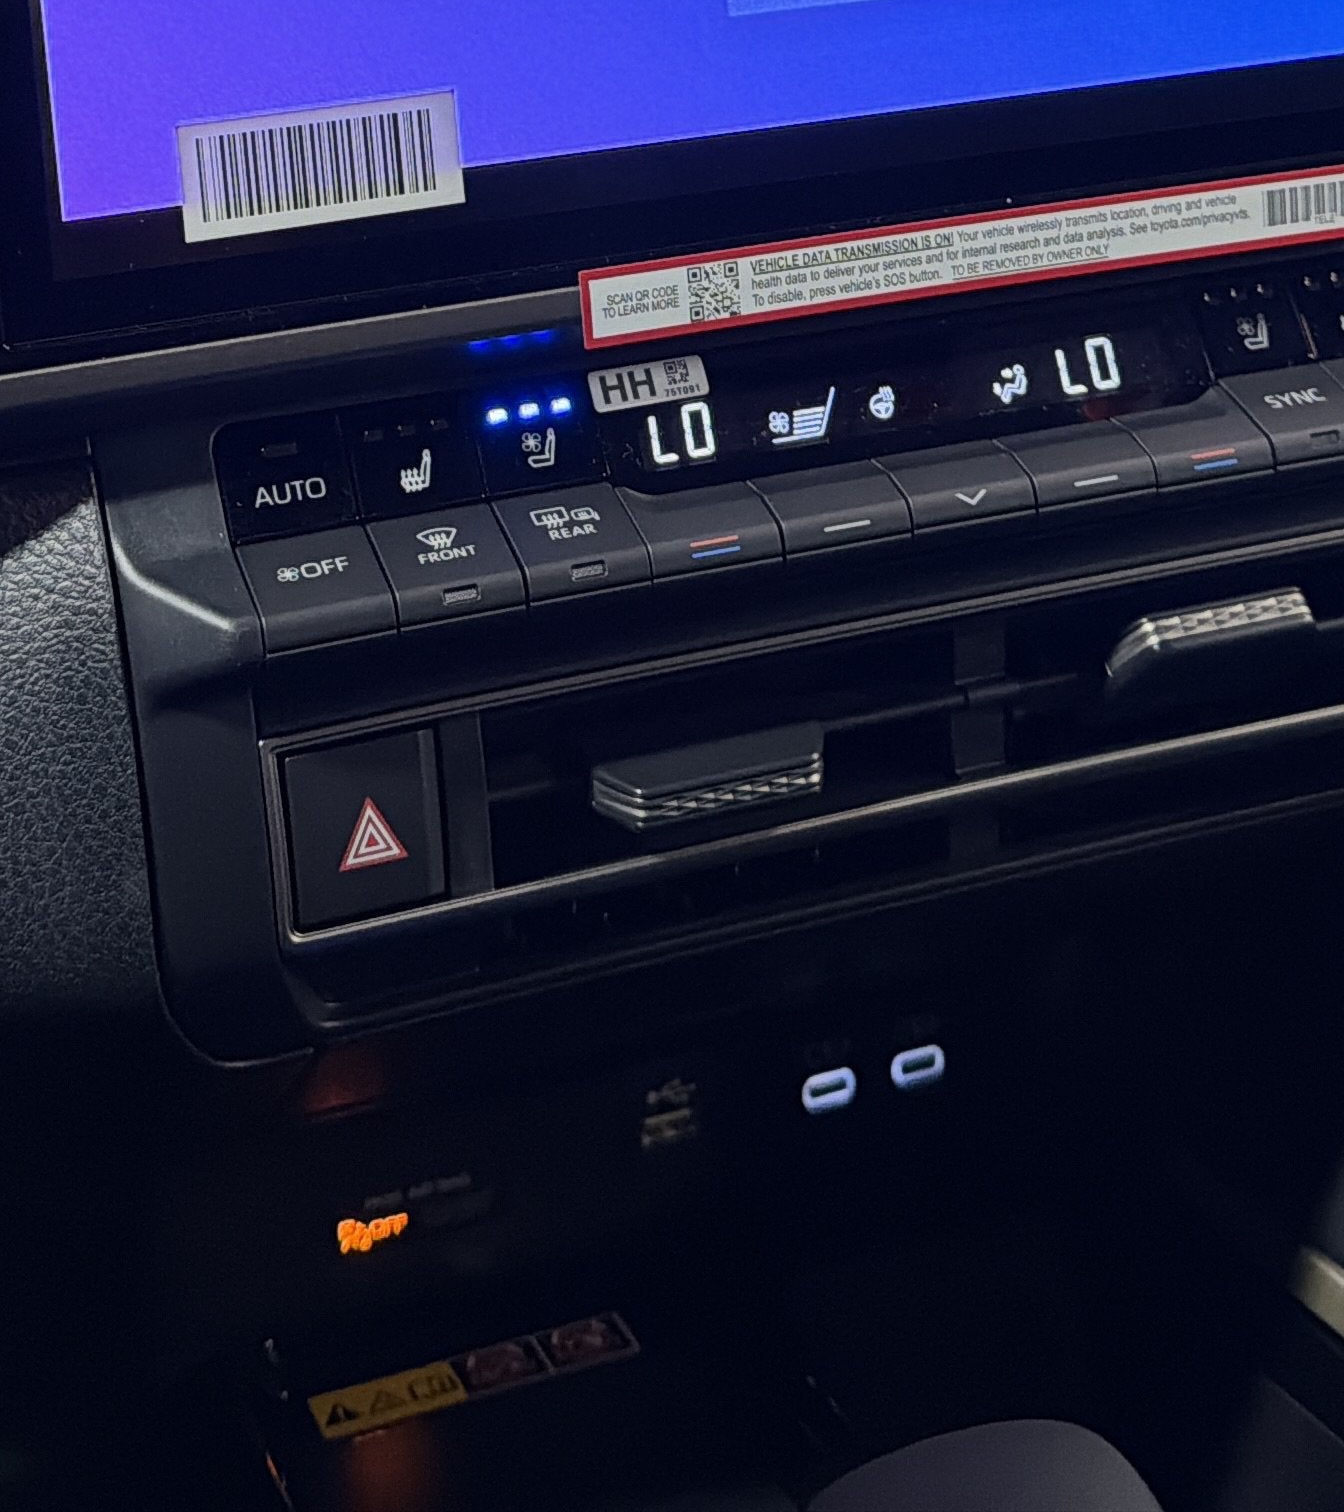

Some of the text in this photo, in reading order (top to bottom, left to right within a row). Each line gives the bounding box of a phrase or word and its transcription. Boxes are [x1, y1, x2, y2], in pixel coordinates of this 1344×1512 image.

[750, 254, 799, 273] VEHICLE
[803, 249, 832, 266] DATA
[834, 234, 918, 260] TRANSMISSION
[921, 234, 931, 248] IS
[957, 228, 979, 244] Your
[981, 223, 1015, 240] vehicle
[1017, 216, 1062, 236] wirelessly
[1065, 211, 1108, 228] transmits
[1151, 200, 1182, 218] driving
[1185, 198, 1202, 212] and
[1205, 193, 1237, 209] vehicle
[751, 273, 782, 291] health
[785, 269, 807, 284] data
[810, 267, 821, 282] to
[823, 264, 856, 281] deliver
[858, 259, 880, 278] your
[882, 255, 923, 272] services
[925, 250, 944, 264] and
[946, 247, 958, 262] for
[961, 242, 997, 259] internal
[999, 236, 1041, 254] research
[1043, 232, 1061, 247] and
[1063, 228, 1084, 244] data
[1129, 221, 1148, 236] See
[951, 242, 1110, 277] TO BE REMOVED BY OWNER ONLY
[606, 285, 679, 307] SCAN QR CODE
[752, 268, 943, 307] To disable, press vehicle's SOS button.
[603, 297, 680, 319] TO LEARN MORE
[599, 368, 657, 404] HH
[1264, 385, 1326, 410] SYNC
[254, 477, 327, 509] AUTO
[548, 523, 597, 541] REAR
[300, 556, 349, 580] OFF
[418, 543, 476, 565] FRONT
